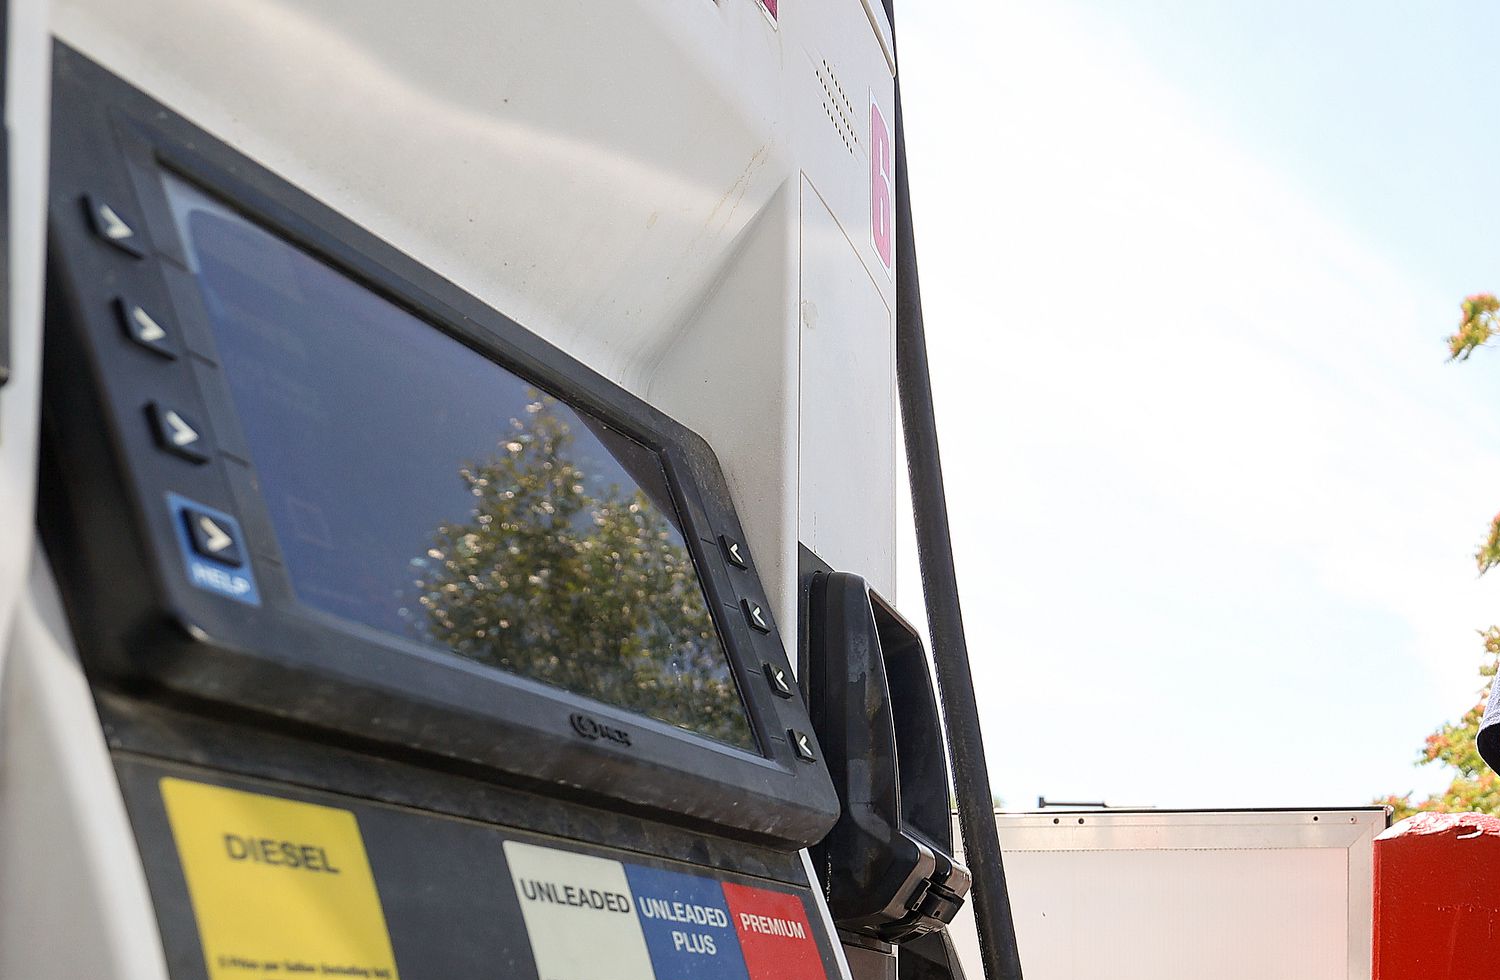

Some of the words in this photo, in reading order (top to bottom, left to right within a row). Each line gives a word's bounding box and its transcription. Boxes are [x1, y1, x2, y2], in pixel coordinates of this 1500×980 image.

[872, 103, 890, 268] 6
[222, 833, 341, 875] DIESEL
[520, 878, 630, 914] UNLEADED
[638, 896, 728, 928] UNLEADED
[671, 930, 717, 956] PLUS
[739, 912, 806, 940] PREMIUM
